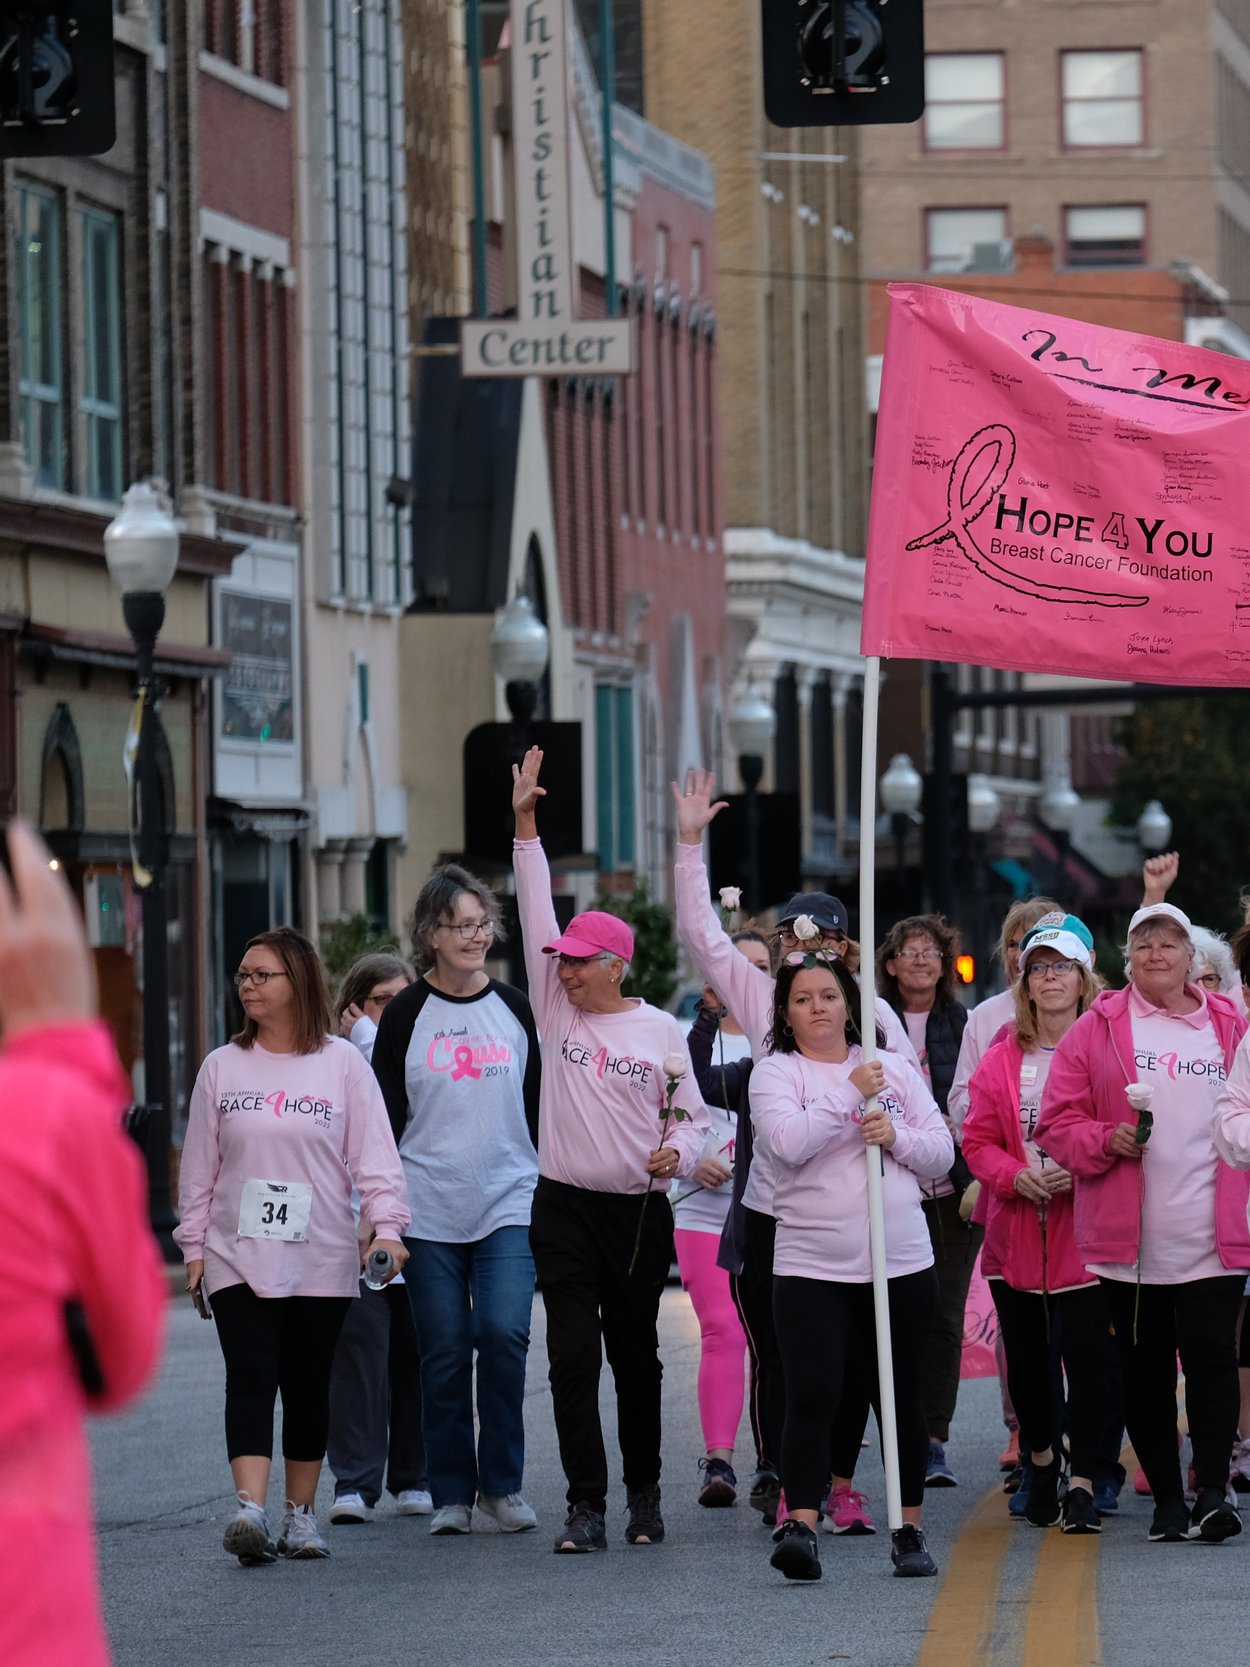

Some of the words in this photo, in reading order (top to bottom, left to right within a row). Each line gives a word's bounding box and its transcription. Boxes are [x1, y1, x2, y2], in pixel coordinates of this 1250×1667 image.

[479, 328, 616, 369] Center
[1022, 329, 1103, 372] In
[1101, 512, 1129, 549] 4
[991, 538, 1044, 562] Breast
[1050, 548, 1112, 571] Cancer
[1118, 557, 1213, 582] Foundation
[485, 1066, 509, 1077] 2019
[591, 1047, 608, 1079] 4
[605, 1057, 652, 1084] HOPE
[1135, 1054, 1157, 1071] CE
[1157, 1052, 1177, 1080] 4
[1178, 1061, 1226, 1081] HOPE
[629, 1080, 646, 1091] 2022
[220, 1097, 264, 1113] RACE
[264, 1090, 286, 1118] 4
[284, 1099, 333, 1121] HOPE
[1019, 1108, 1037, 1124] CE
[314, 1118, 331, 1129] 2022
[261, 1202, 288, 1225] 34
